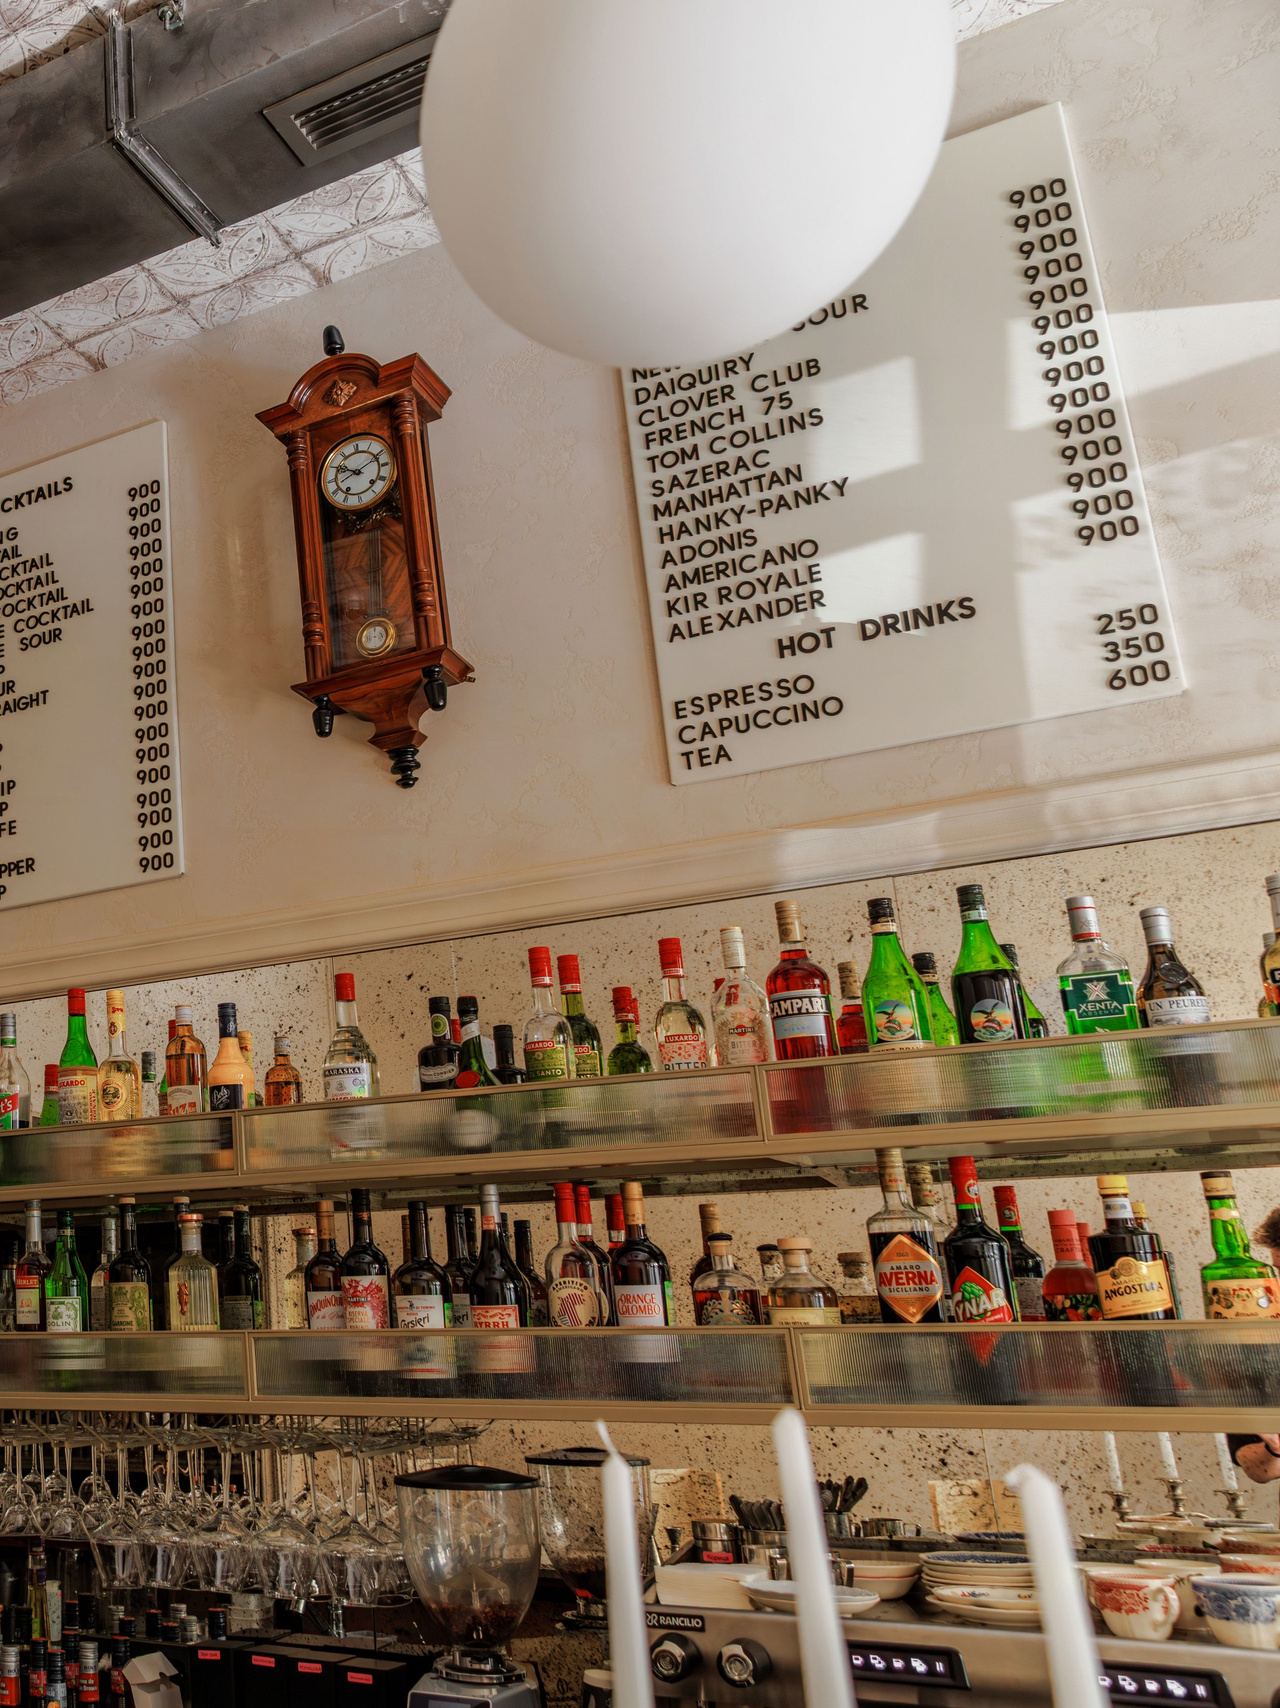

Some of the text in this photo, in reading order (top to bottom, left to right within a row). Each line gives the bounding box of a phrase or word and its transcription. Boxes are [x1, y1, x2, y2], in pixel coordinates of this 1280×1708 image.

[1009, 178, 1066, 209] 900
[1014, 202, 1072, 233] 900
[1019, 228, 1077, 260] 900
[635, 253, 1082, 405] DAIQUIRY 900
[638, 278, 1087, 427] CLOVER CLUB 900
[645, 304, 1093, 450] FRENCH 75 900
[647, 330, 1098, 473] TOM COLLINS 900
[652, 356, 1104, 497] SAZERAC 900
[653, 382, 1110, 521] MANHATTAN 900
[659, 409, 1116, 544] HANKY-PANKY 900
[128, 480, 160, 501] 900
[129, 498, 160, 521] 900
[661, 436, 1122, 569] ADONIS 900
[129, 518, 161, 540] 900
[665, 462, 1127, 593] AMERICANO 900
[130, 538, 162, 560] 900
[667, 490, 1133, 617] KIR ROYALE 900
[130, 558, 163, 580] 900
[669, 516, 1139, 643] ALEXANDER 900
[14, 599, 94, 633] COCKTAIL
[131, 577, 163, 599] 900
[20, 628, 62, 651] SOUR
[131, 598, 164, 619] 900
[132, 619, 165, 640] 900
[778, 597, 975, 658] HOT DRINKS
[133, 638, 165, 661] 900
[133, 659, 166, 679] 900
[674, 604, 1158, 719] ESPRESSO 250
[134, 679, 166, 700] 900
[678, 632, 1164, 744] CAPUCCINO 350
[134, 700, 167, 721] 900
[681, 660, 1170, 770] TEA 600
[135, 722, 168, 743] 900
[136, 743, 169, 764] 900
[137, 765, 170, 785] 900
[137, 788, 171, 808] 900
[138, 807, 172, 828] 900
[139, 830, 172, 851] 900
[139, 852, 173, 873] 900
[1079, 1001, 1122, 1013] XENTA
[1149, 1002, 1162, 1011] UN
[525, 1041, 554, 1050] LUXARDO
[665, 1034, 699, 1043] LUXARDO
[325, 1069, 361, 1077] MARASKA
[538, 1068, 561, 1076] SANTO
[552, 1280, 588, 1291] APERITIVO
[878, 1270, 939, 1287] AVERNA
[620, 1293, 656, 1304] ORANGE
[1104, 1281, 1164, 1301] ANGOSTURA
[617, 1299, 661, 1316] COLOMBO
[659, 1615, 703, 1628] RANCILIO
